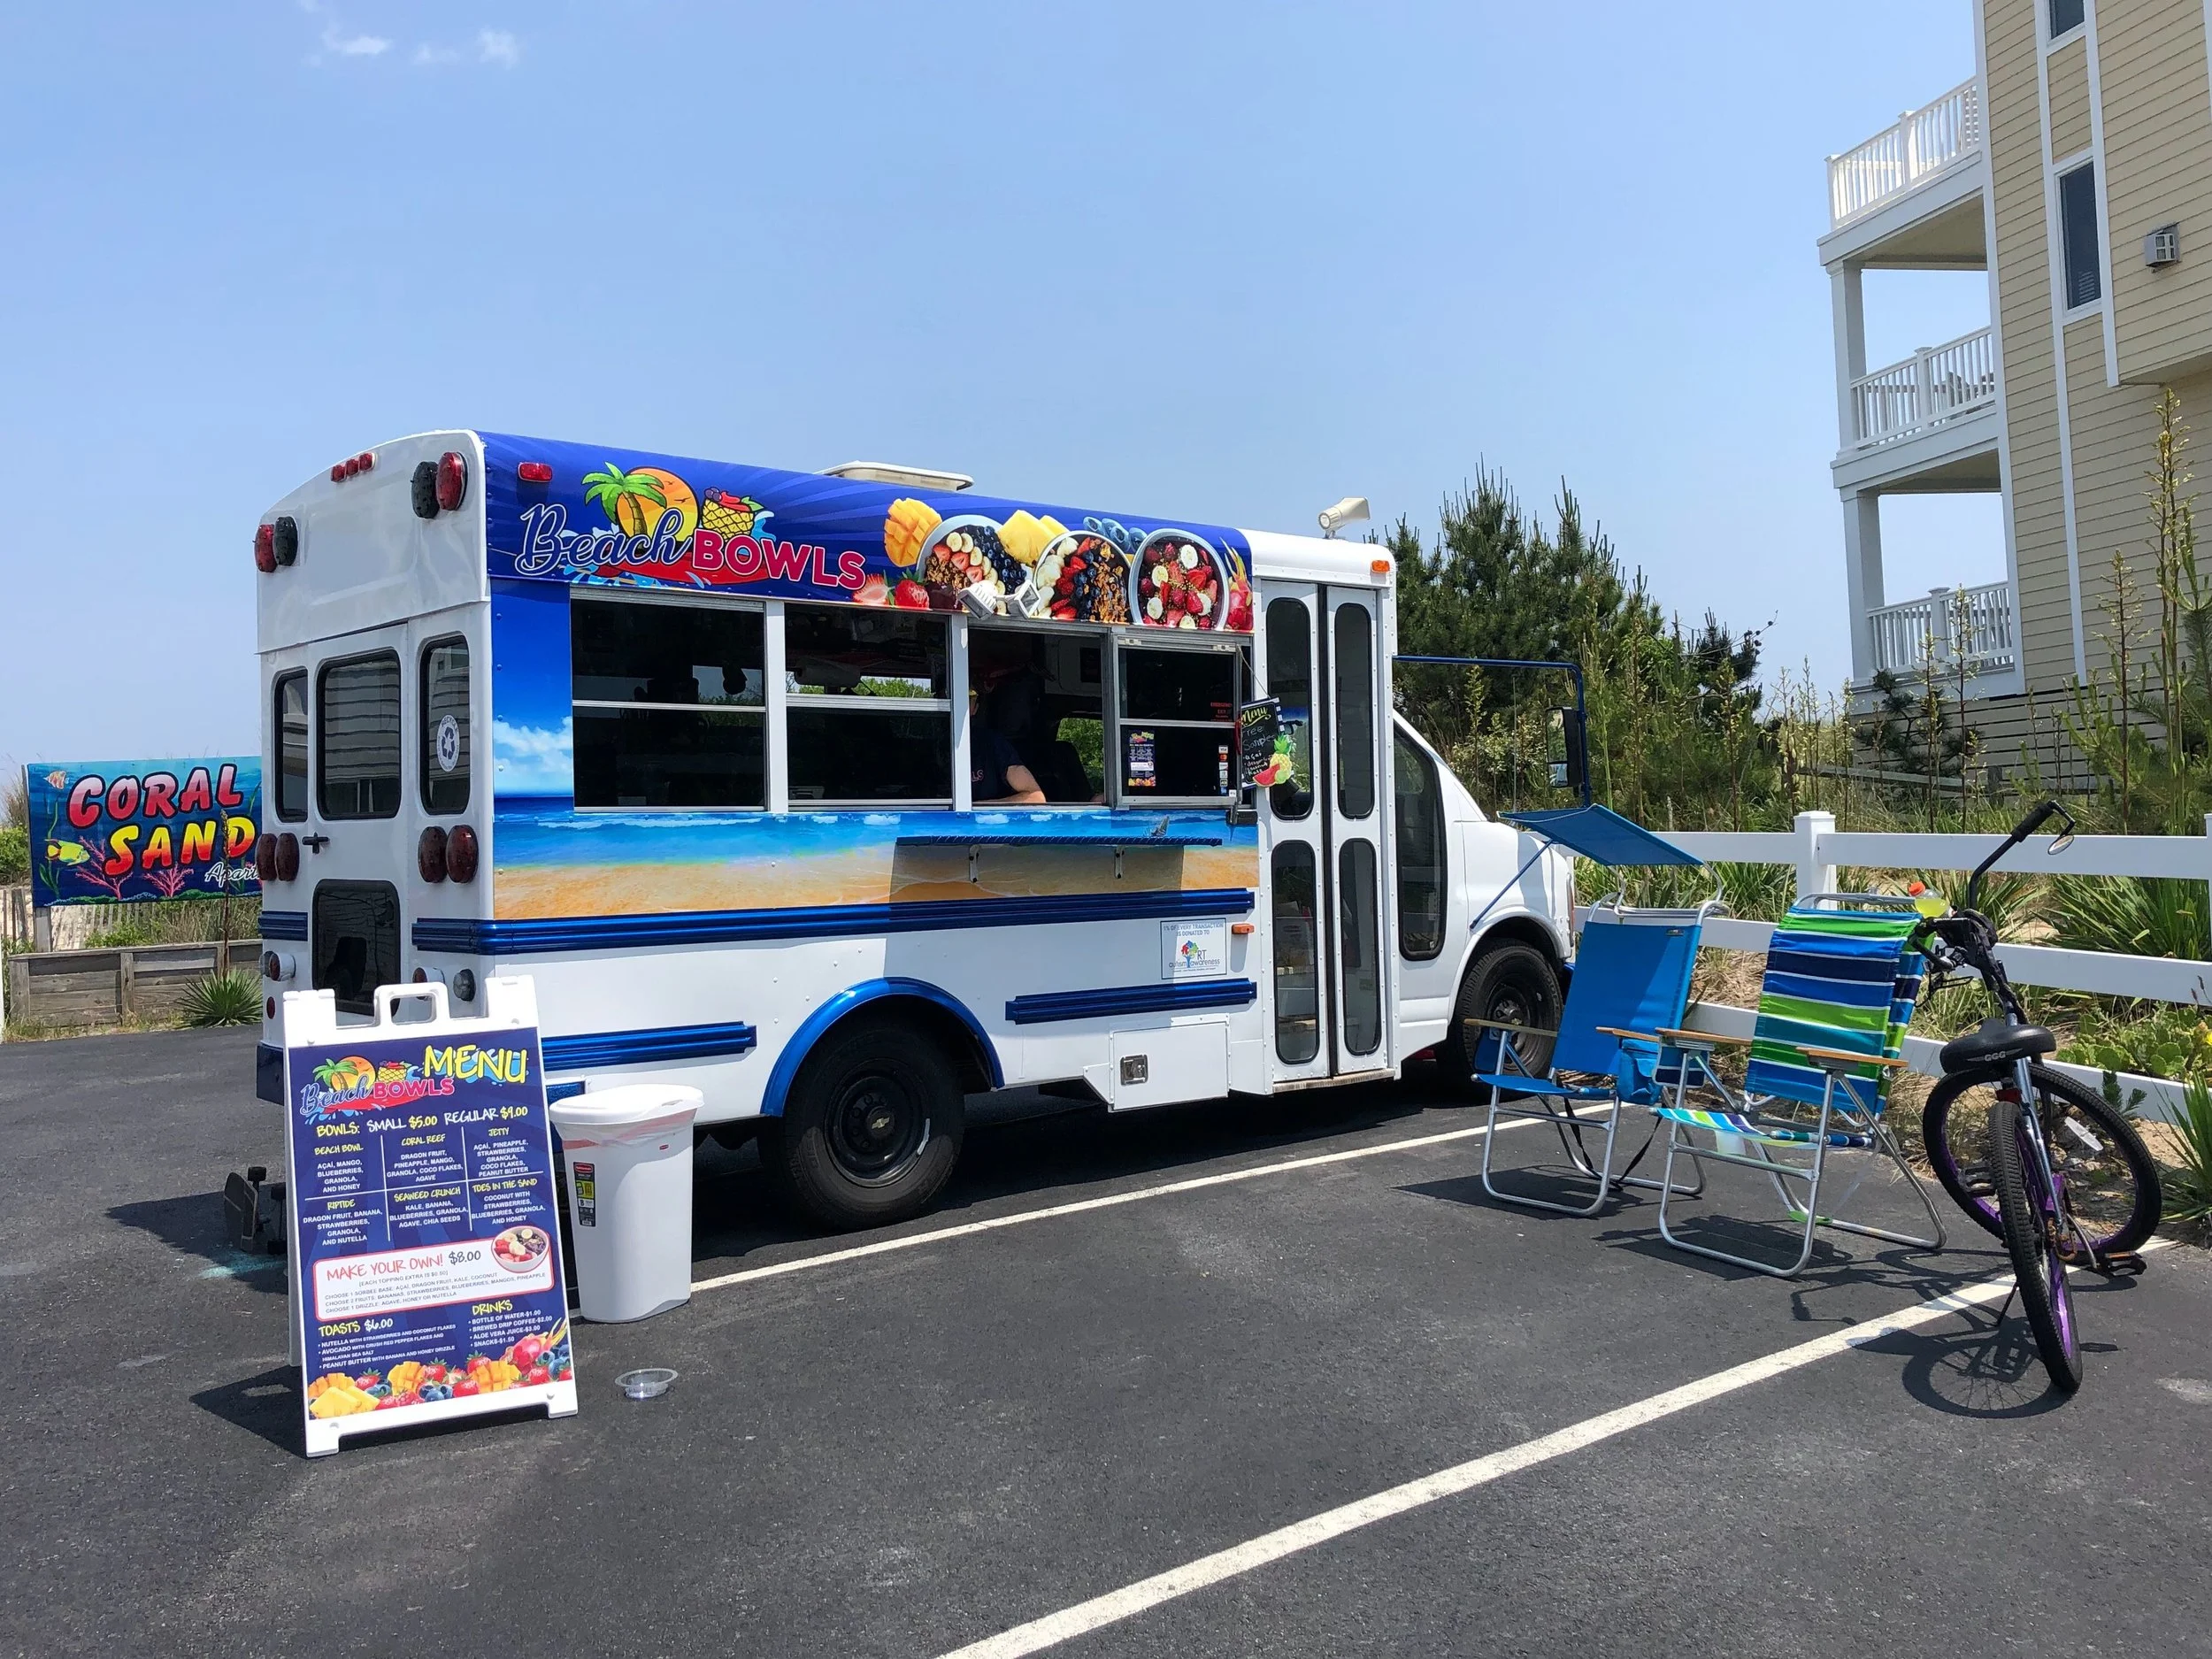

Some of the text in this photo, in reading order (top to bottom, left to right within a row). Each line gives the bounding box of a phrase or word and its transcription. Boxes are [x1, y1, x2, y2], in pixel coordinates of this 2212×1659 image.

[514, 503, 866, 590] Beach BOWLS
[66, 764, 243, 829] CORAL
[103, 813, 257, 877] SAND
[204, 862, 261, 887] Apart
[425, 1044, 527, 1083] MENU
[300, 1074, 455, 1115] Beach BOWLS
[317, 1106, 528, 1137] BOWLS: SMALL $5.00 REGULAR $9.00
[488, 1127, 510, 1136] JETTY
[401, 1133, 446, 1146] CORAL REEF
[493, 1139, 528, 1149] PINEAPPLE,
[314, 1142, 363, 1156] BEACH BOWL
[400, 1151, 426, 1160] DRAGON
[477, 1146, 526, 1157] STRAWBERRIES,
[336, 1158, 362, 1168] MANGO,
[394, 1156, 454, 1169] PINEAPPLE, MANGO,
[486, 1154, 518, 1163] GRANOLA,
[499, 1159, 525, 1168] FLAKES,
[317, 1167, 363, 1178] BLUEBERRIES,
[387, 1168, 419, 1178] GRANOLA,
[324, 1175, 357, 1185] GRANOLA,
[472, 1178, 537, 1193] TOES IN THE SAND
[394, 1186, 460, 1202] SEAWEED CRUNCH
[483, 1192, 513, 1202] COCONUT
[326, 1198, 355, 1210] RIPTIDE
[425, 1200, 453, 1209] BANANA,
[483, 1198, 531, 1210] STRAWBERRIES,
[303, 1208, 382, 1224] DRAGON FRUIT, BANANA,
[389, 1206, 468, 1221] BLUEBERRIES, GRANOLA,
[471, 1204, 545, 1219] BLUEBERRIES, GRANOLA,
[317, 1217, 370, 1230] STRAWBERRIES,
[398, 1219, 421, 1228] AGAVE,
[327, 1226, 361, 1237] GRANOLA,
[337, 1234, 367, 1243] NUTELLA
[326, 1250, 481, 1281] MAKE YOUR OWN! $8.00
[472, 1299, 513, 1315] DRINKS
[472, 1316, 494, 1325] BOTTLE
[503, 1310, 541, 1320] WATER-$1.00
[319, 1317, 393, 1336] TOASTS $6.00
[472, 1323, 497, 1332] BREWED
